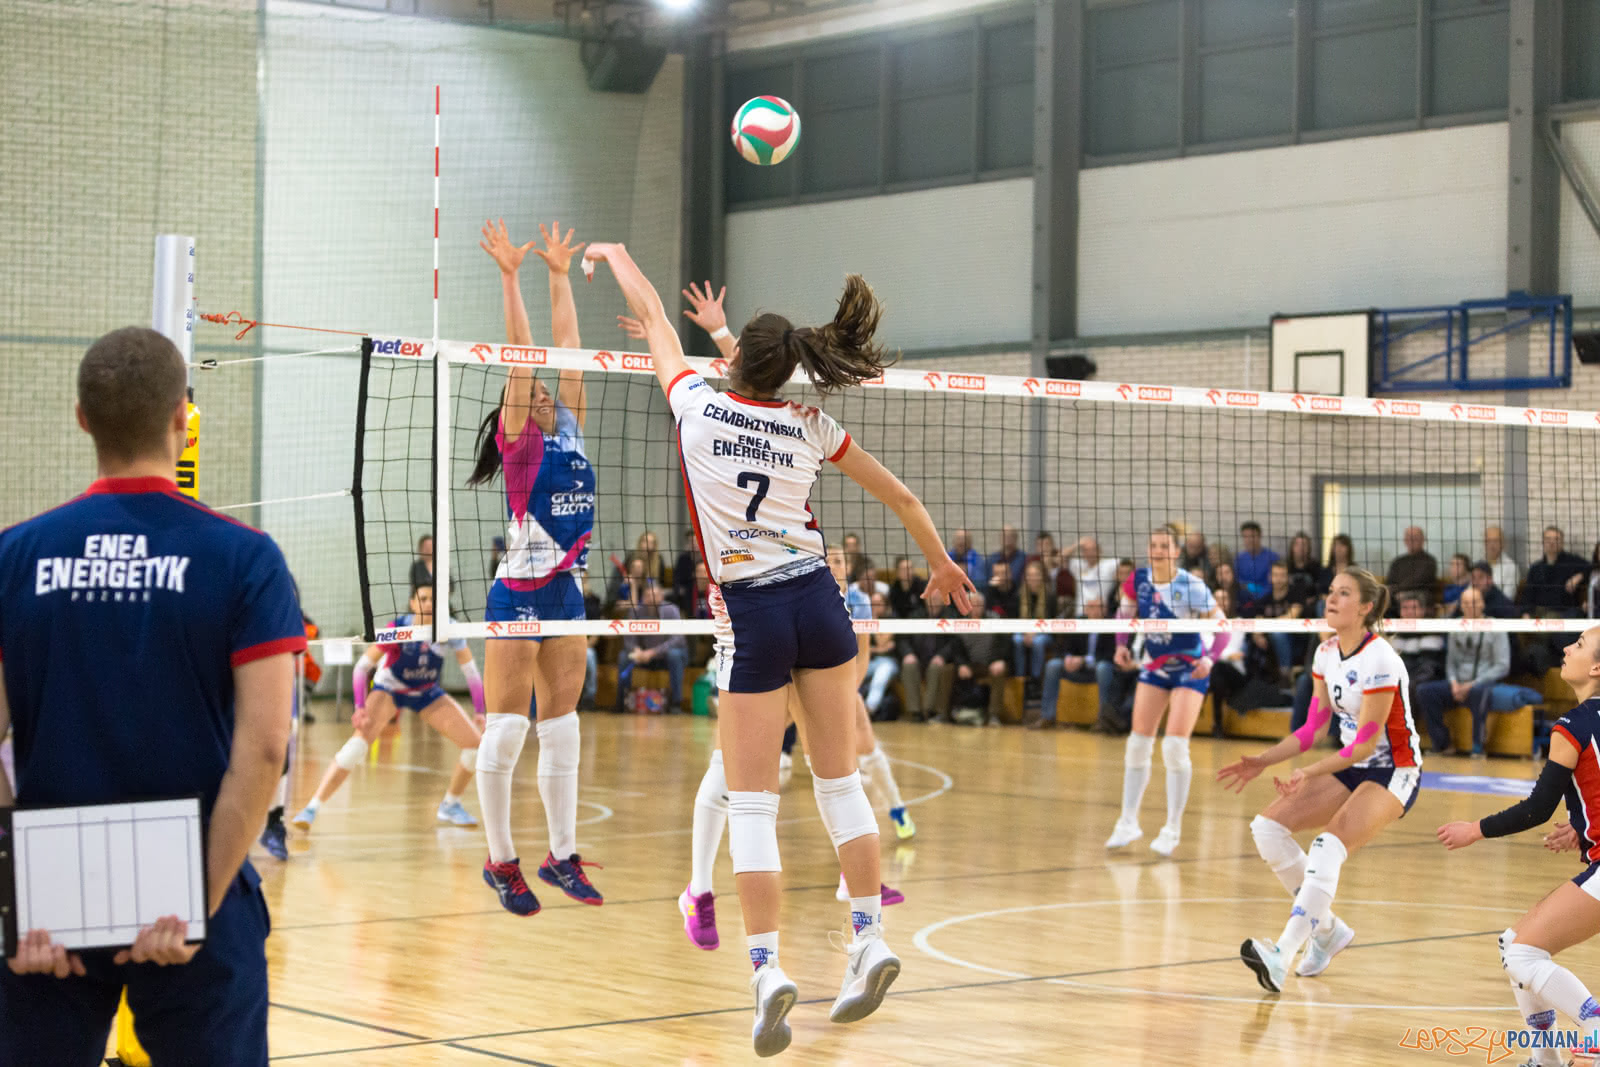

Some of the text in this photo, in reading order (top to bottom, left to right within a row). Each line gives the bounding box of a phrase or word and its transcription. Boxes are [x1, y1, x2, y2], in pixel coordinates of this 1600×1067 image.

[371, 338, 424, 356] netex
[502, 349, 545, 363] ORLEN
[624, 356, 656, 369] ORLE
[949, 376, 984, 389] ORLEN
[1047, 382, 1079, 395] ORLEN
[1140, 388, 1171, 400] ORLEN
[1227, 393, 1258, 405] ORLEN
[1312, 398, 1341, 409] ORLEN
[703, 403, 806, 441] CEMBRZYŃSKA
[738, 435, 771, 451] ENEA
[713, 439, 794, 468] ENERGETYK
[737, 471, 770, 522] 7
[84, 534, 148, 559] ENEA
[35, 556, 191, 596] ENERGETYK
[508, 622, 540, 634] ORLEN
[629, 621, 660, 632] ORLEN
[376, 630, 413, 642] netex
